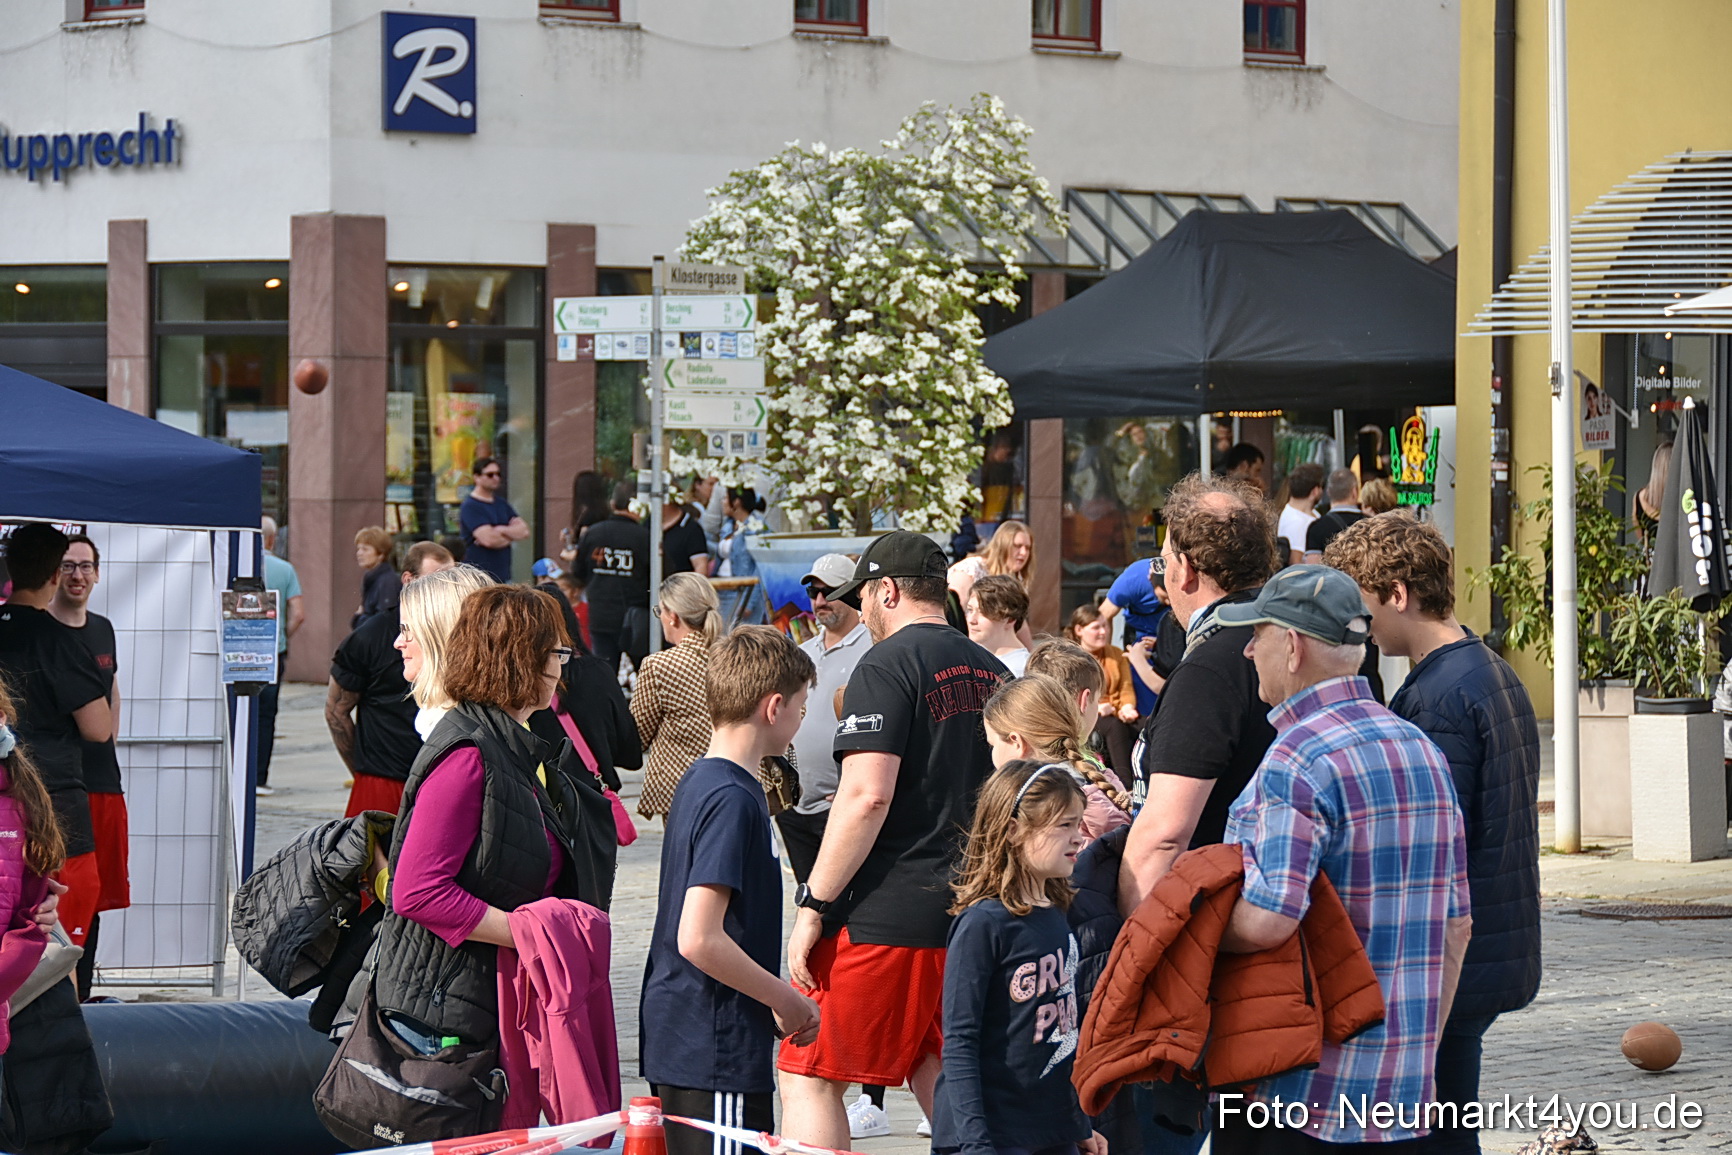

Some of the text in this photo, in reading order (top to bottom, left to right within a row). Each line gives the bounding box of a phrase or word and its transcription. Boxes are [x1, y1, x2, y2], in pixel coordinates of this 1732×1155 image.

[0, 112, 175, 181] upprecht
[671, 267, 737, 288] Klostergasse
[687, 363, 713, 373] Radinfo
[687, 376, 727, 385] Ladestation
[1636, 376, 1701, 392] Digitale Bilder
[1590, 419, 1606, 430] PASS
[1586, 431, 1609, 442] BILDER
[934, 665, 972, 683] AMERICA
[1009, 948, 1071, 1003] GRL
[373, 1128, 403, 1144] Wolfskin
[374, 1122, 392, 1135] Jack
